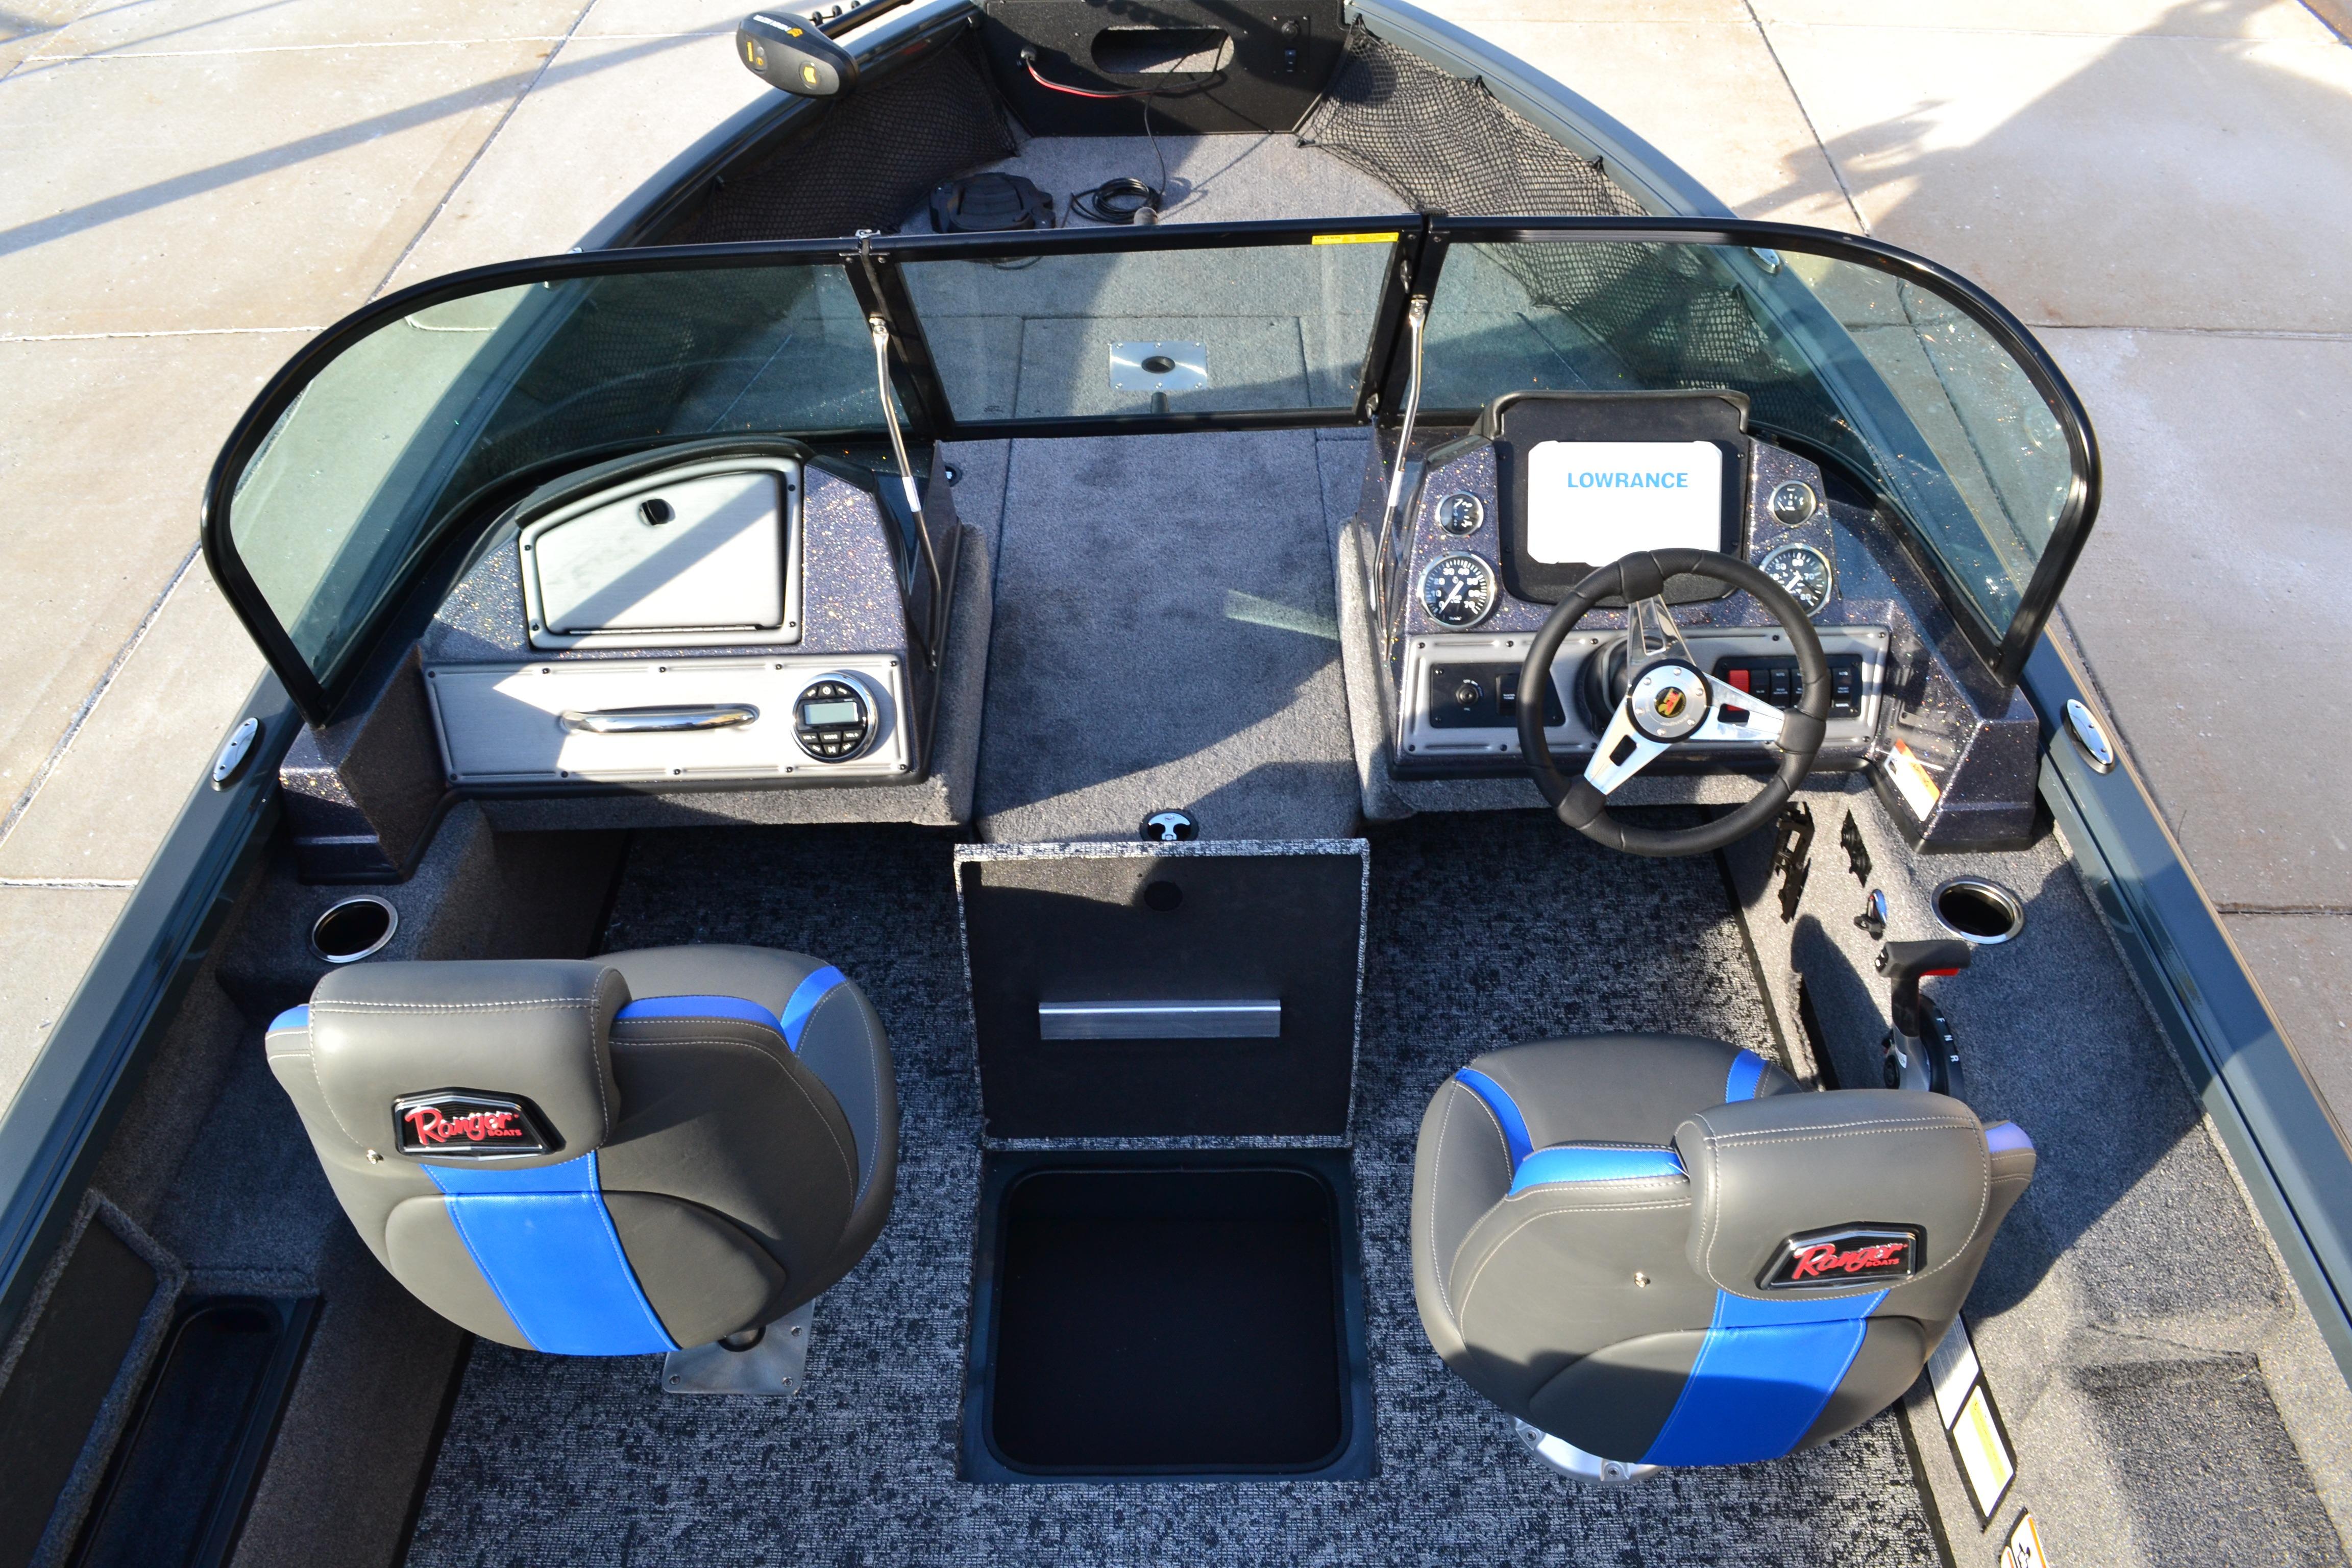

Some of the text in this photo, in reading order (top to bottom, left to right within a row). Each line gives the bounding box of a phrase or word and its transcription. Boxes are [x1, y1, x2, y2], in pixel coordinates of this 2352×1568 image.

[1567, 472, 1688, 488] LOWRANCE
[404, 1106, 512, 1145] Ranger
[1792, 1243, 1903, 1280] Ranger
[1866, 1258, 1900, 1267] BOATS
